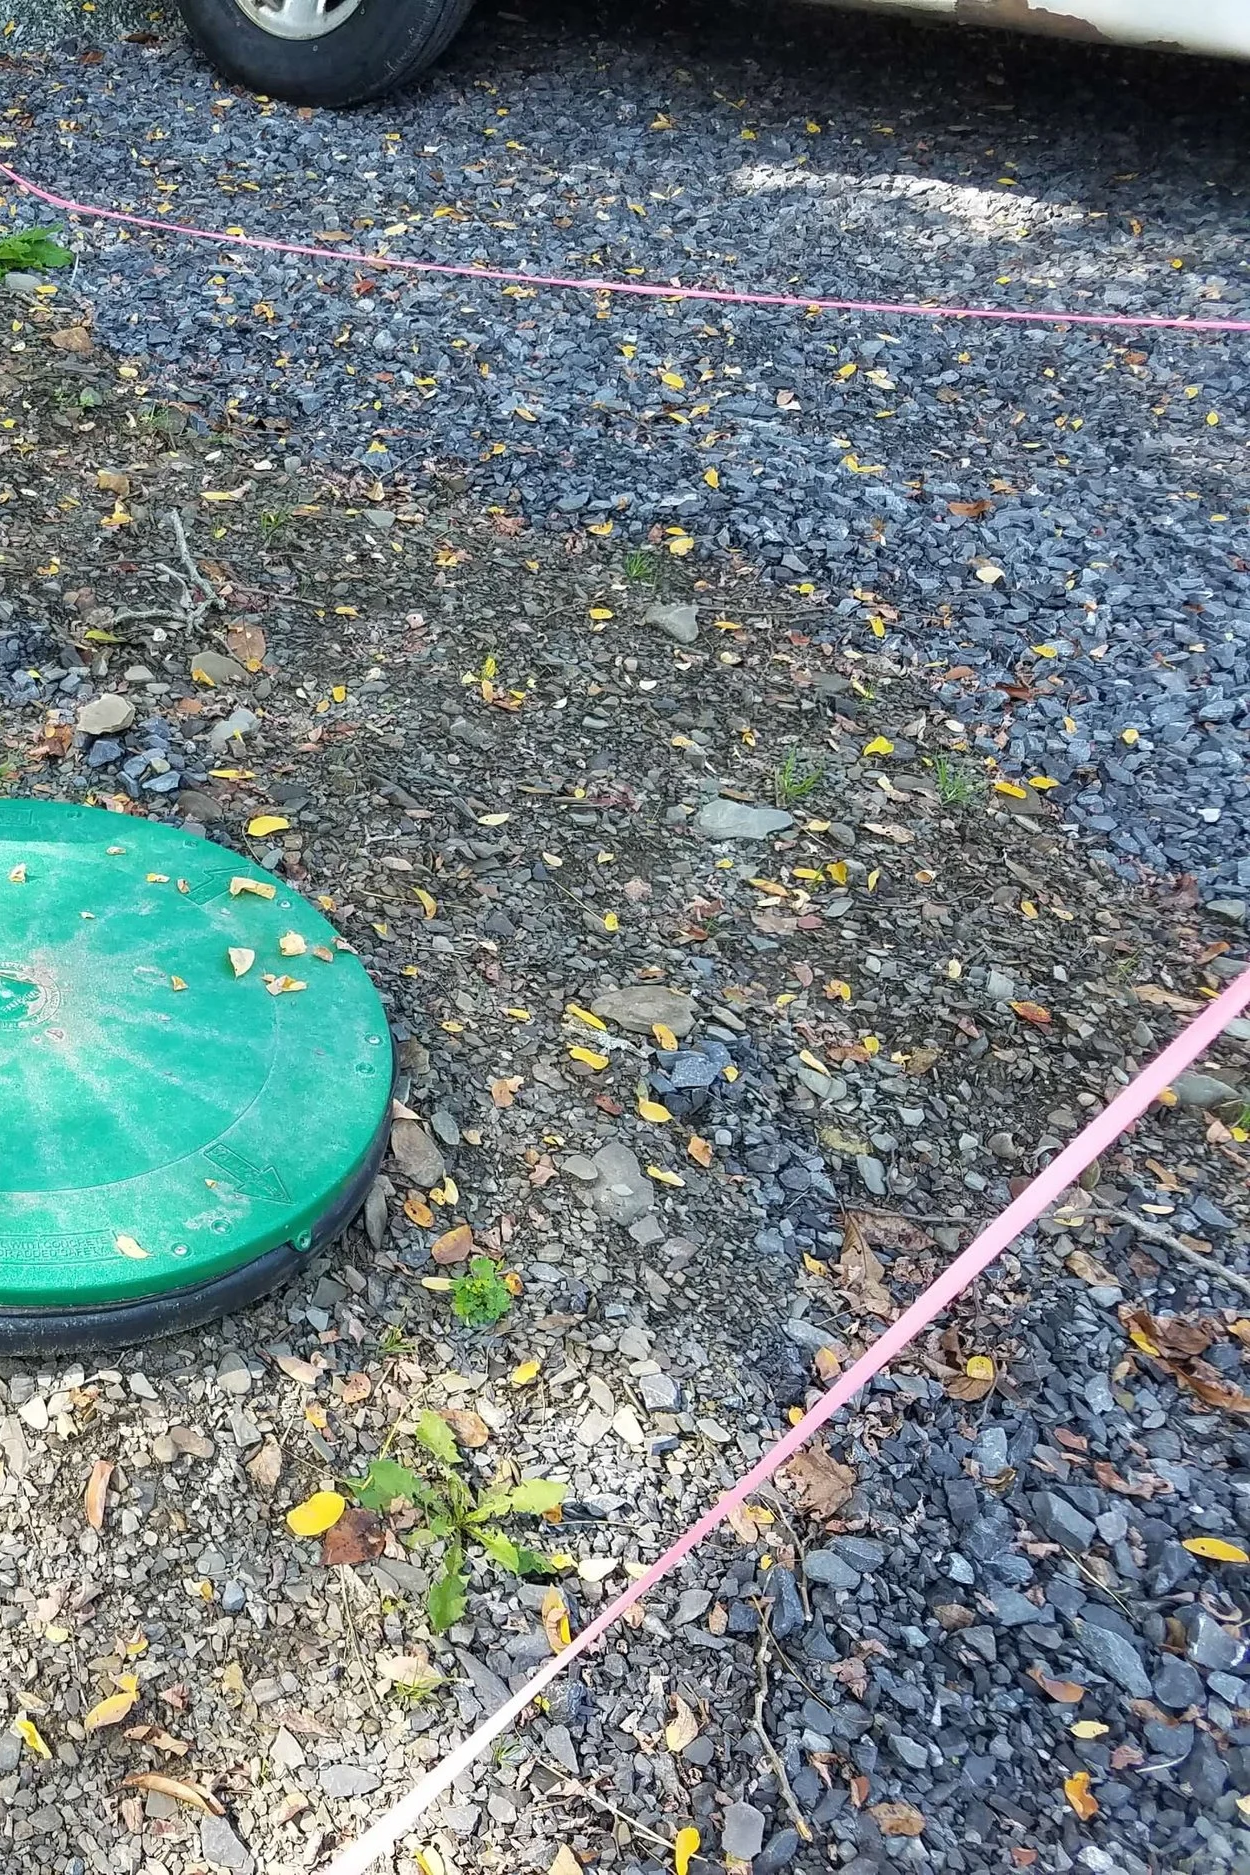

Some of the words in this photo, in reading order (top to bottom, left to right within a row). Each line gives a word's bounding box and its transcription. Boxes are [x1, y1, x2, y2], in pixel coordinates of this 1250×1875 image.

[11, 1240, 41, 1250] WITH
[43, 1236, 109, 1249] CONCRETE
[16, 1249, 58, 1259] ADDED
[60, 1246, 105, 1257] SAFETY
